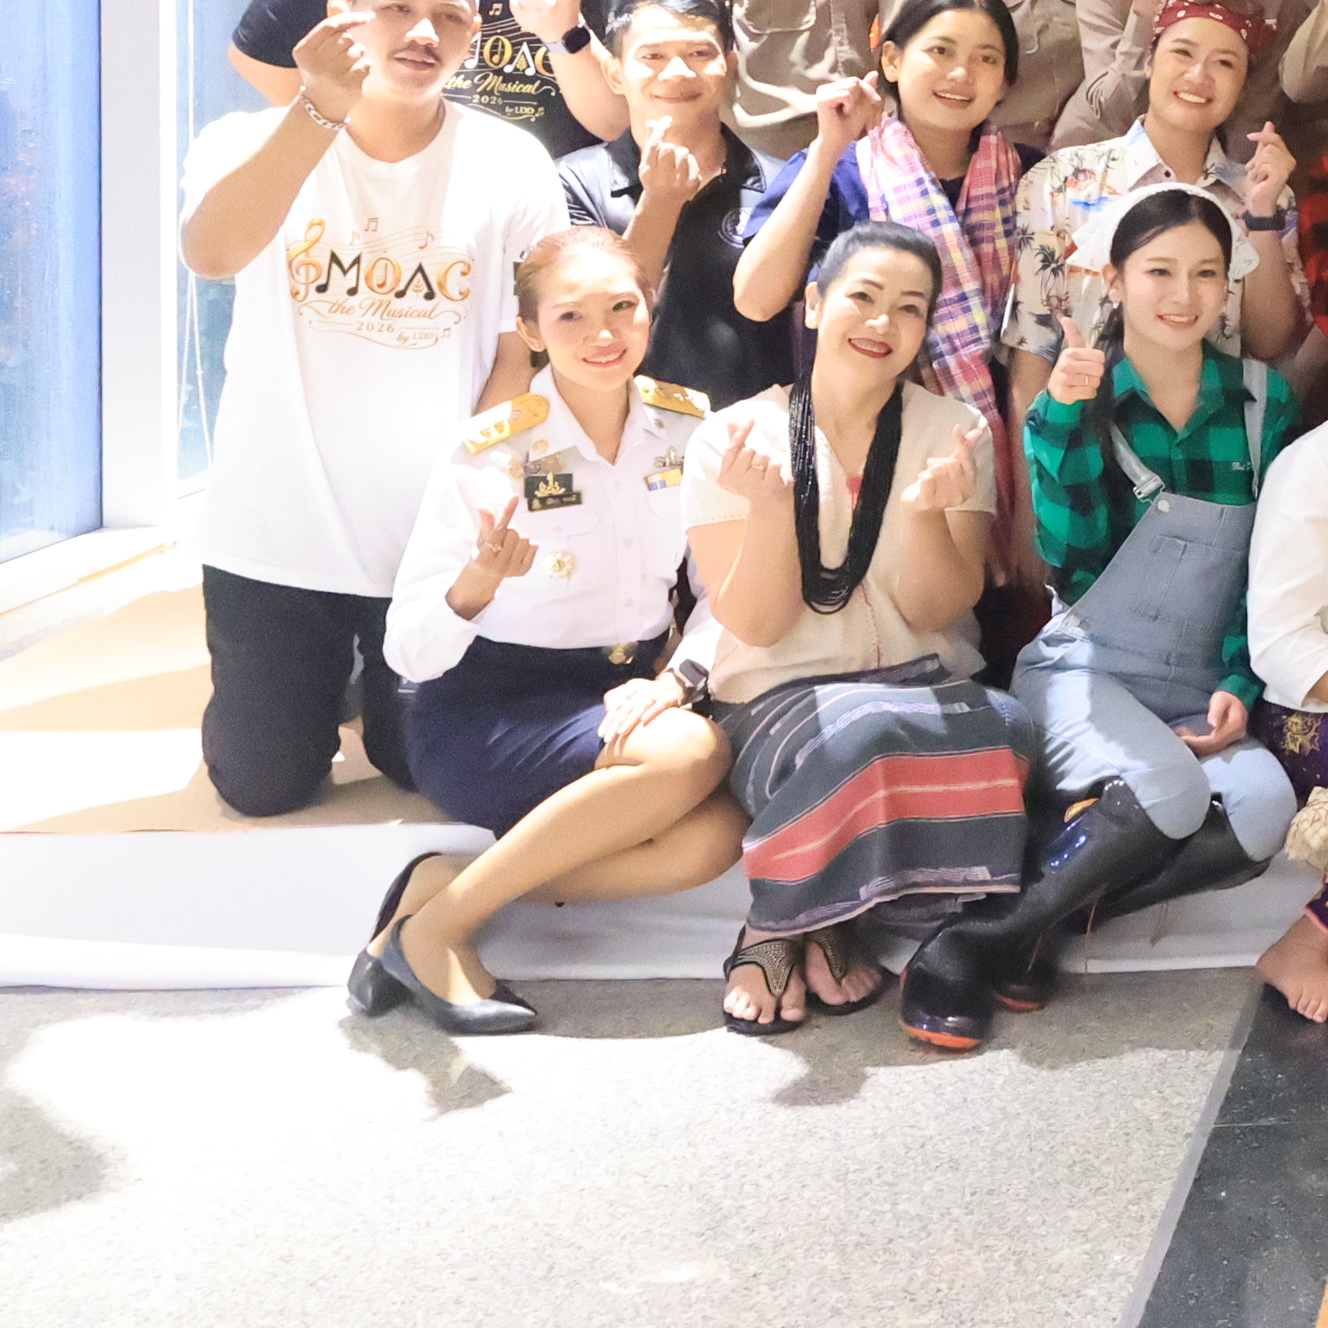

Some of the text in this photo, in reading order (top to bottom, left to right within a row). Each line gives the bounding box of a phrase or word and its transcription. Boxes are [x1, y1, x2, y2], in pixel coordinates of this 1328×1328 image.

[473, 71, 545, 96] Musical
[471, 94, 503, 105] 2026
[315, 249, 473, 302] MOAC
[328, 297, 441, 321] the Musical
[356, 321, 395, 334] 2026
[397, 331, 434, 344] by LDD
